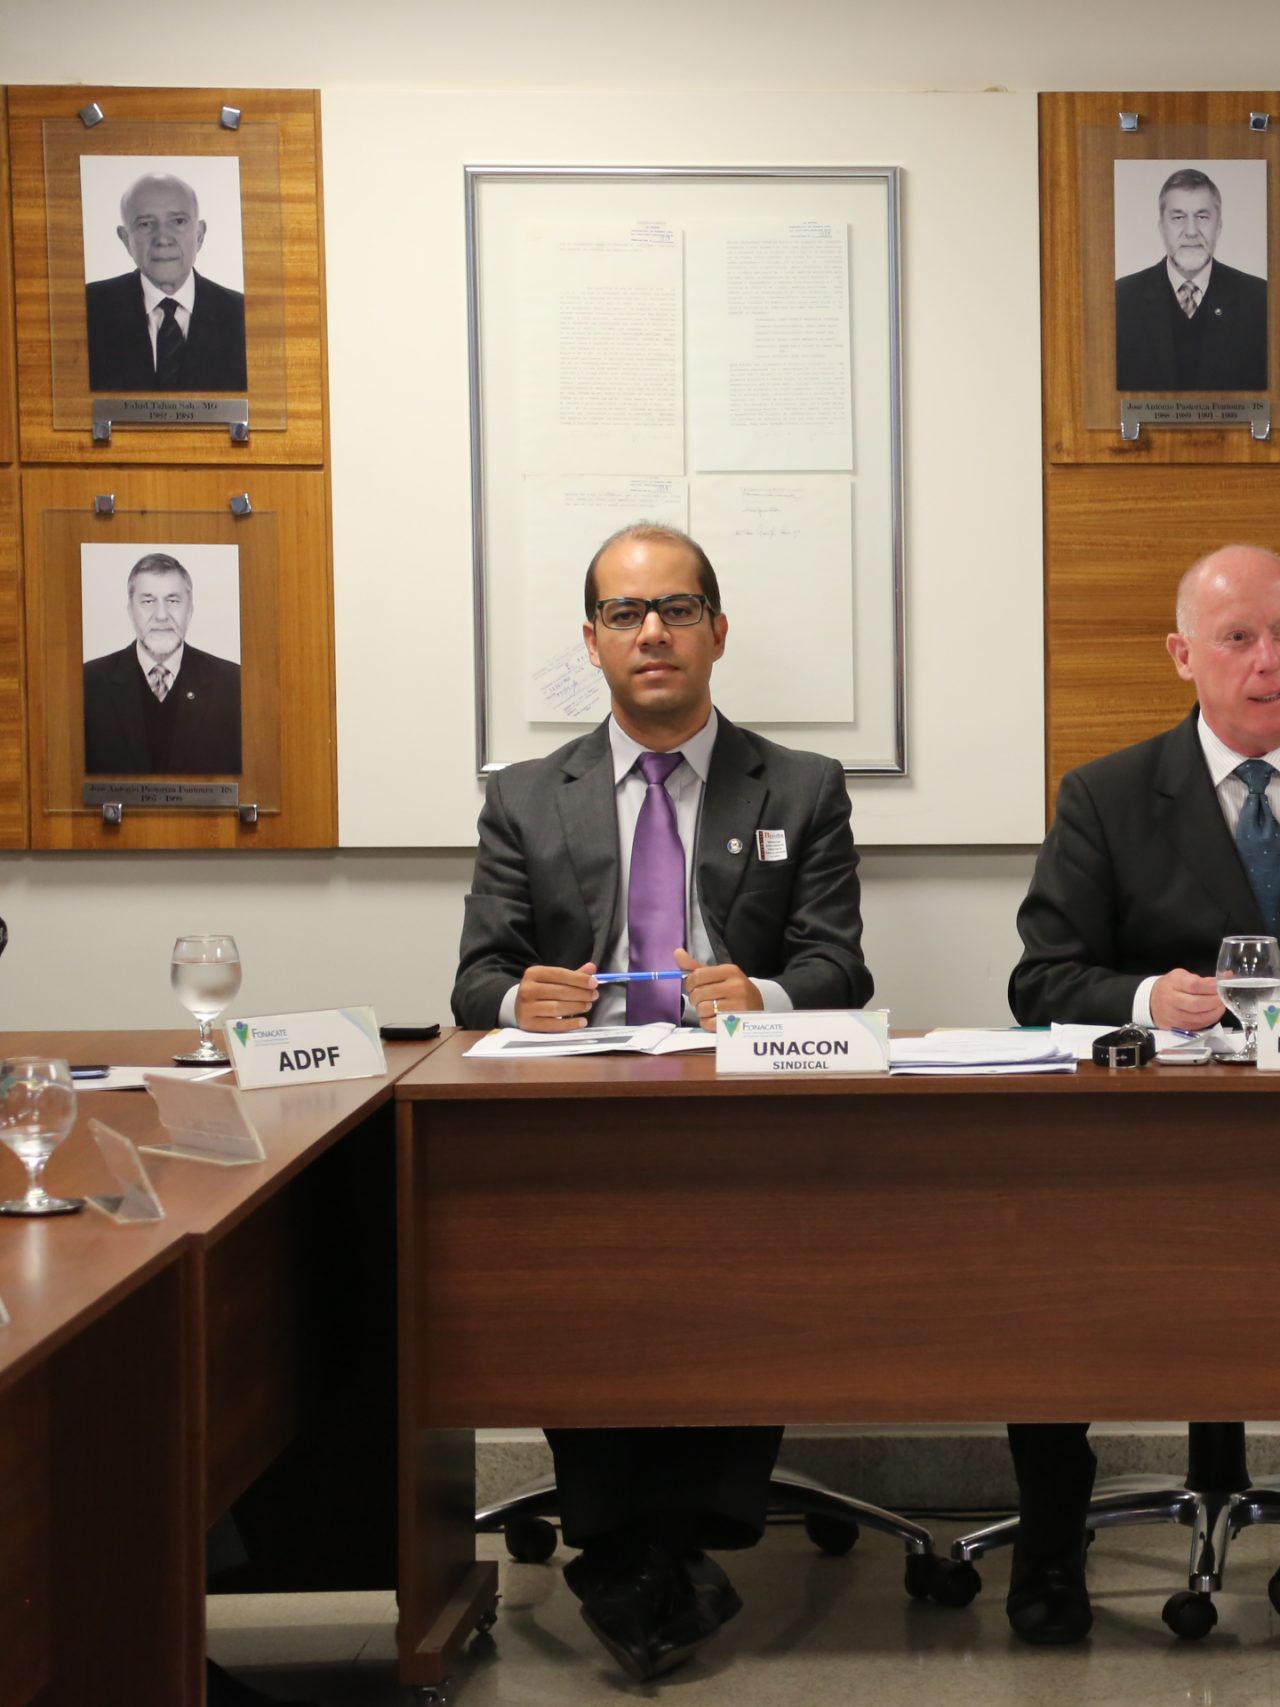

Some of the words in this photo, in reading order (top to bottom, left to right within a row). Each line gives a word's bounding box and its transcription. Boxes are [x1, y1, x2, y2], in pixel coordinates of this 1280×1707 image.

[742, 1021, 784, 1031] FONACATE
[251, 1027, 288, 1039] FONACATE
[752, 1040, 849, 1057] UNACON
[279, 1046, 341, 1072] ADPF
[772, 1060, 829, 1070] SINDICAL
